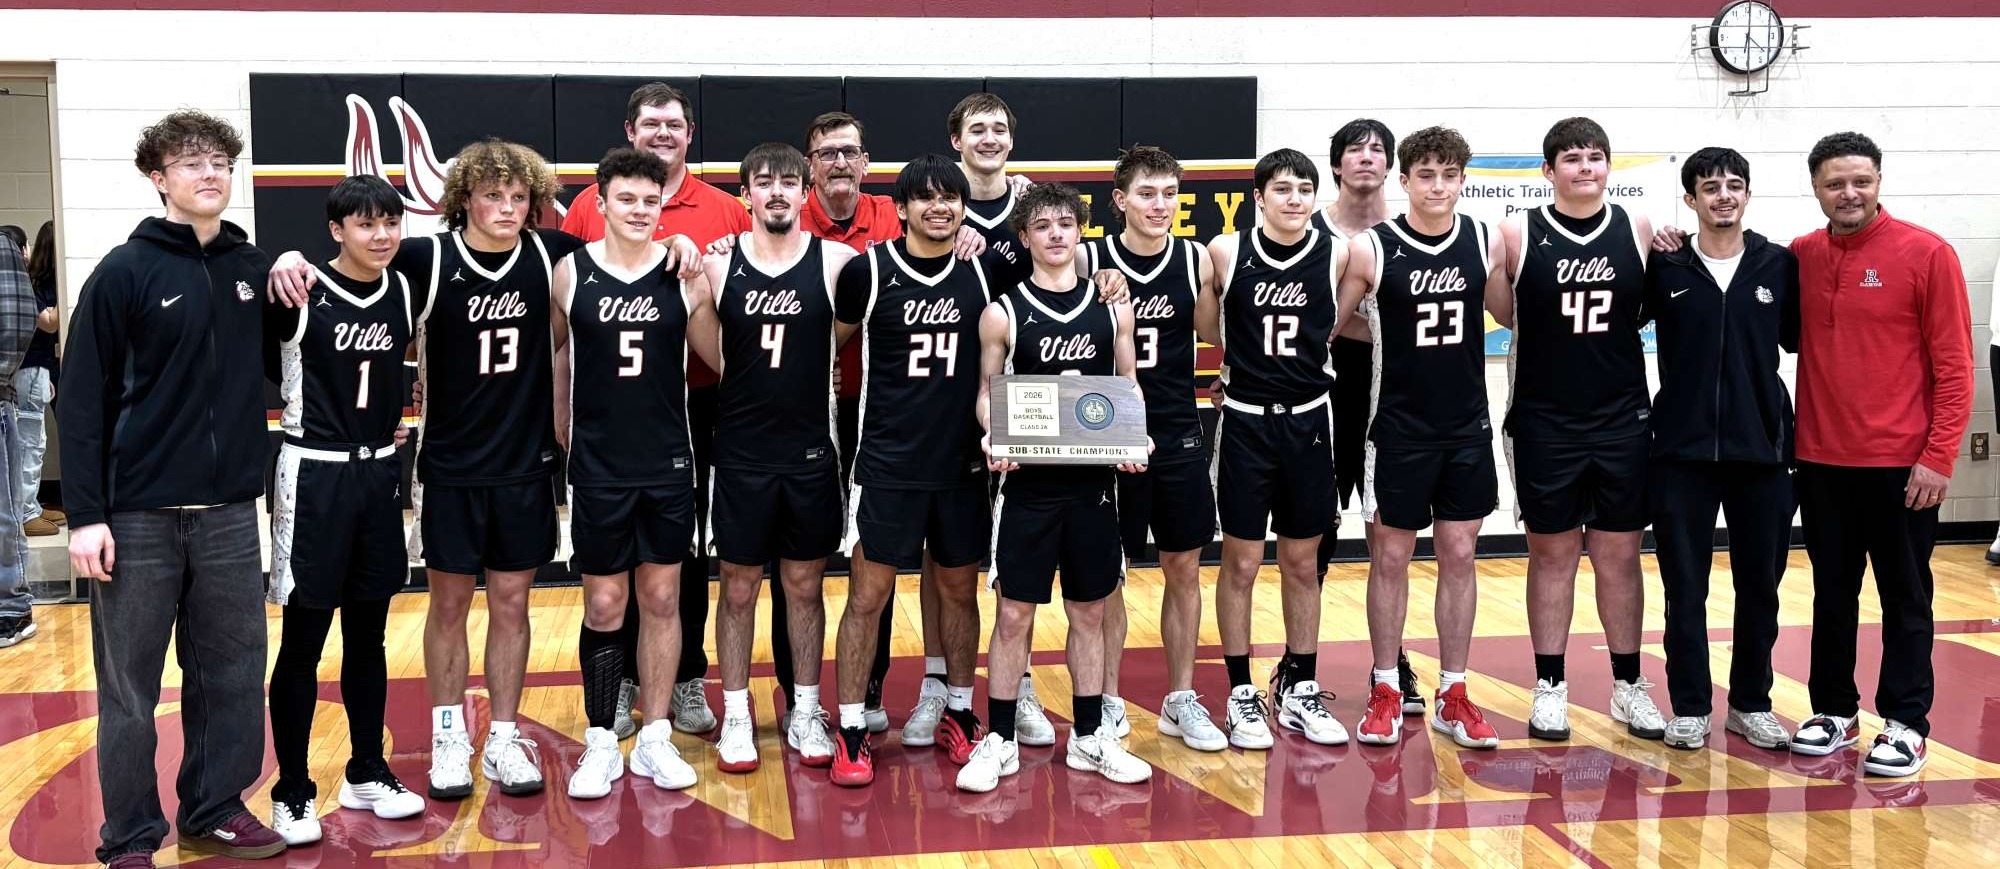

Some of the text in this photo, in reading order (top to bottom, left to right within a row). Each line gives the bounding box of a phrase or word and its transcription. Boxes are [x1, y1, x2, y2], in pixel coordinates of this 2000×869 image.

[1409, 266, 1467, 295] Ville
[1556, 256, 1616, 284] Ville
[467, 290, 527, 322] Ville
[744, 289, 802, 316] Ville
[1253, 281, 1308, 307] Ville
[598, 296, 660, 323] Ville
[903, 297, 961, 326] Ville
[1416, 300, 1464, 347] 23
[1561, 290, 1613, 334] 42
[334, 322, 394, 351] Ville
[760, 323, 785, 368] 4
[1039, 333, 1096, 362] Ville
[1262, 314, 1299, 357] 12
[478, 327, 519, 375] 13
[618, 331, 644, 377] 5
[908, 332, 959, 377] 24
[356, 360, 371, 409] 1
[1023, 391, 1043, 399] 2026
[1008, 446, 1129, 455] SUB-STATE CHAMPIONS
